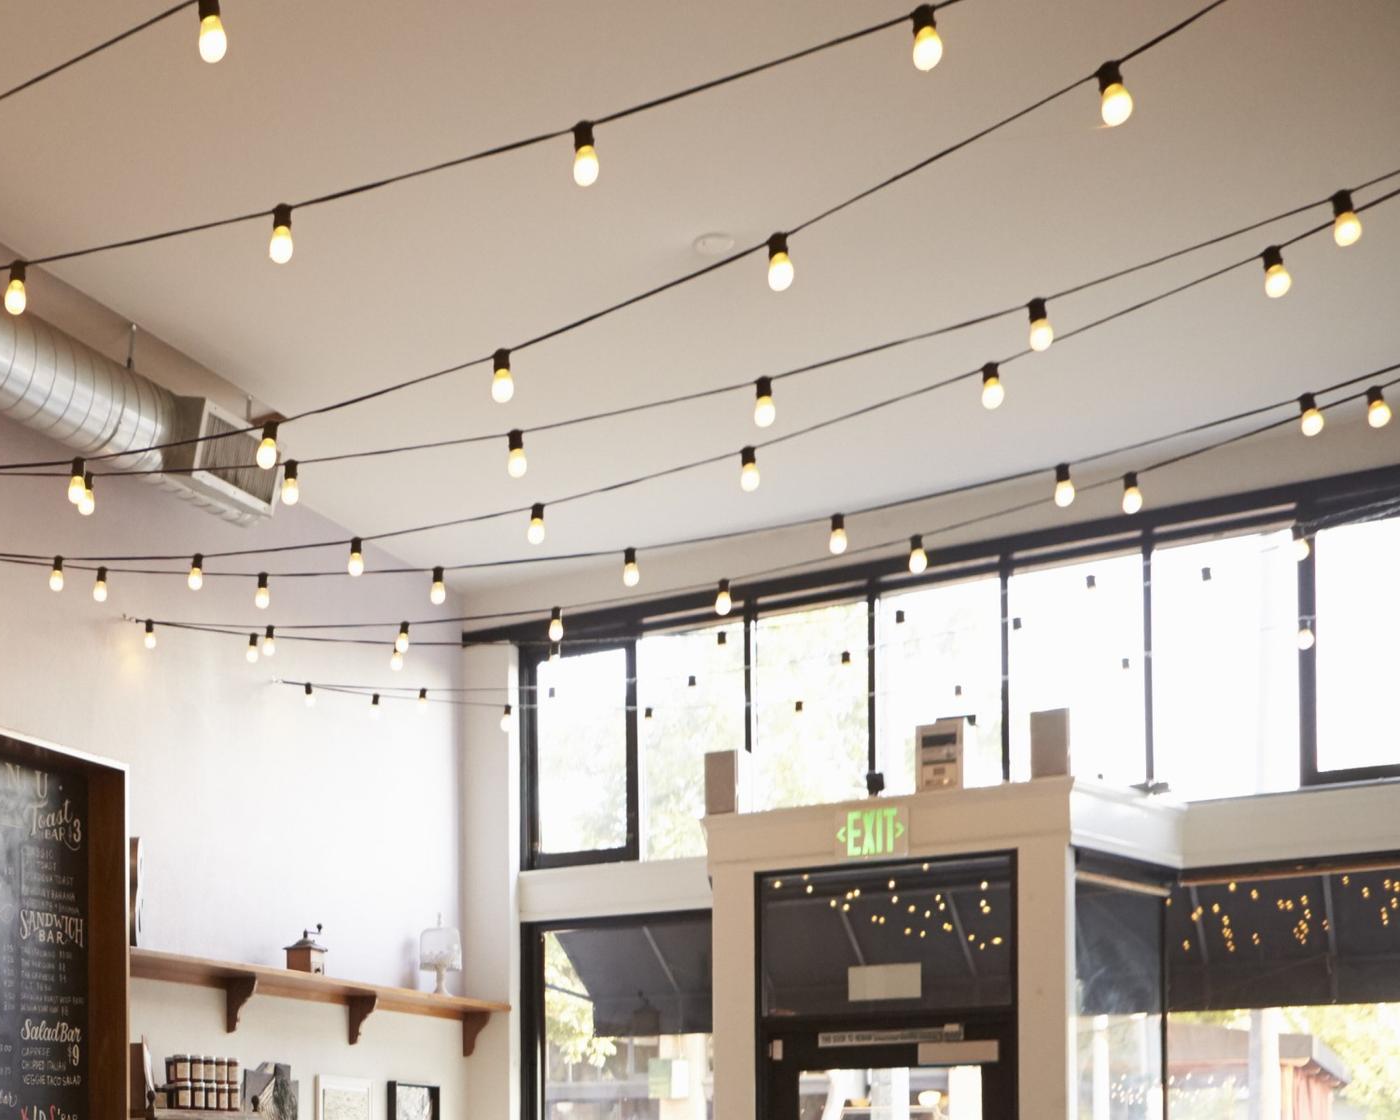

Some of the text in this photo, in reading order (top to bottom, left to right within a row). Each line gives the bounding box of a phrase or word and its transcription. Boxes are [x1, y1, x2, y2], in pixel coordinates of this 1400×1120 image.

[22, 798, 74, 837] Toast
[846, 807, 898, 857] EXIT
[20, 908, 85, 949] SANDWICH
[38, 929, 66, 945] BAR
